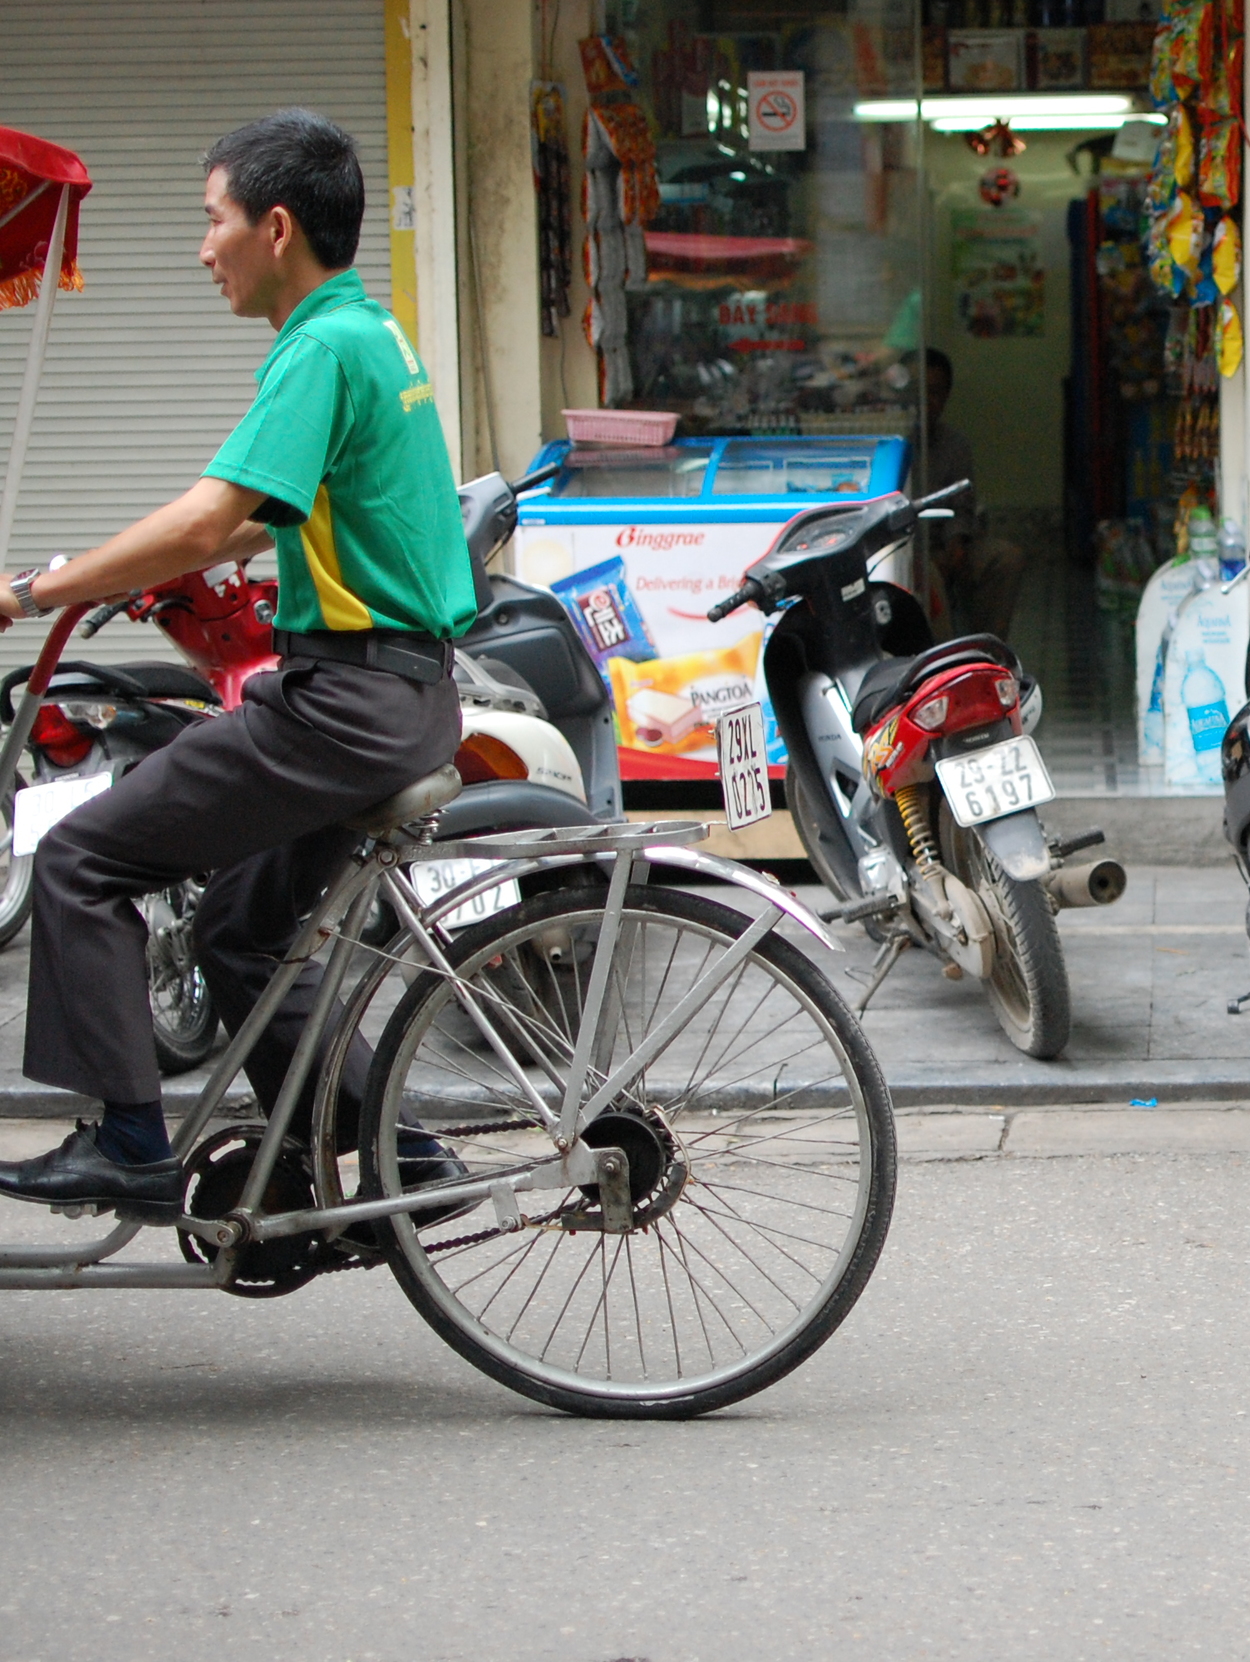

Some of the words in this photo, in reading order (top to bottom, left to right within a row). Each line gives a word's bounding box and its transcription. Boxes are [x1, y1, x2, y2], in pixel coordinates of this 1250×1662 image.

[636, 575, 702, 595] Delivering
[728, 714, 757, 764] 29XL
[965, 773, 1032, 817] 6197
